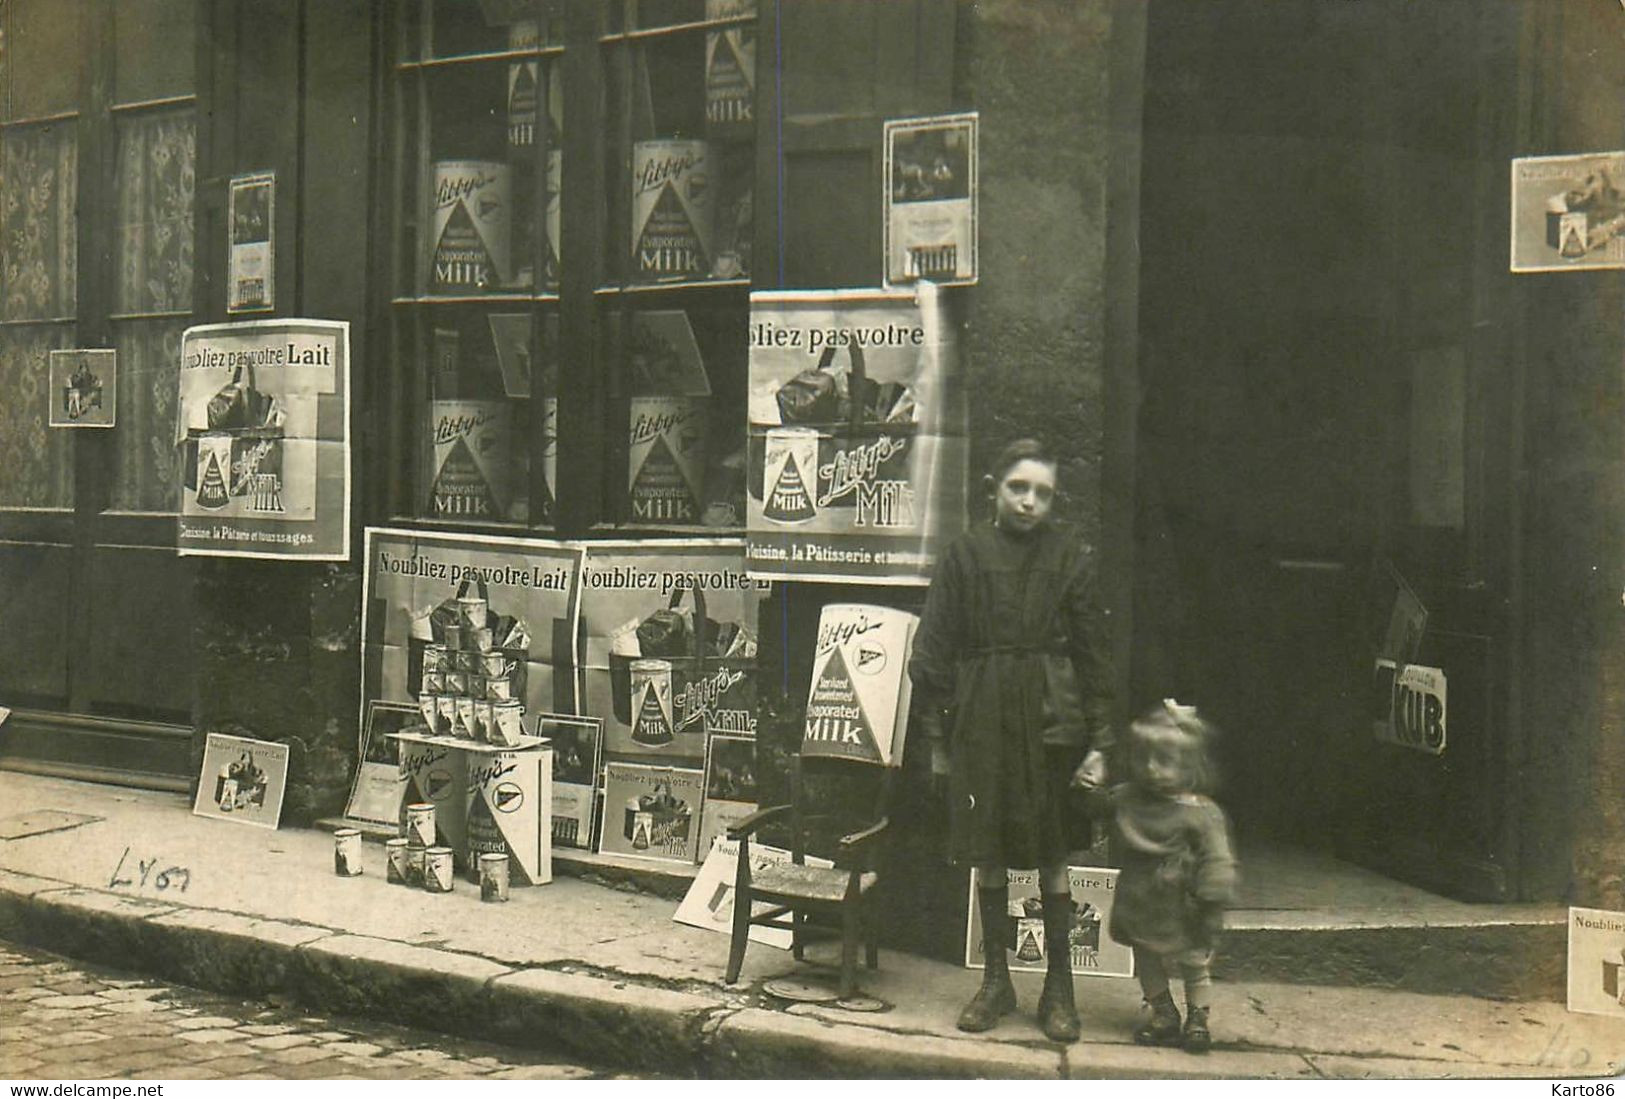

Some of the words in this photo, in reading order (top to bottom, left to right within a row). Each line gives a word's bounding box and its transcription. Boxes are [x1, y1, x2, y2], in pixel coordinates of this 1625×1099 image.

[639, 249, 700, 272] Milk
[435, 262, 489, 284] Milk
[809, 326, 849, 355] pas
[855, 323, 925, 348] votre
[286, 343, 331, 367] Lait
[433, 494, 490, 515] Milk
[631, 498, 692, 520] Milk
[771, 493, 807, 512] Milk
[791, 544, 803, 561] la
[806, 543, 871, 563] Pâtisserie
[450, 564, 479, 587] pas
[482, 566, 530, 587] votre
[532, 565, 568, 591] Lait
[662, 570, 695, 595] pas
[698, 567, 750, 590] votre
[639, 719, 666, 736] Milk
[803, 718, 864, 745] Milk
